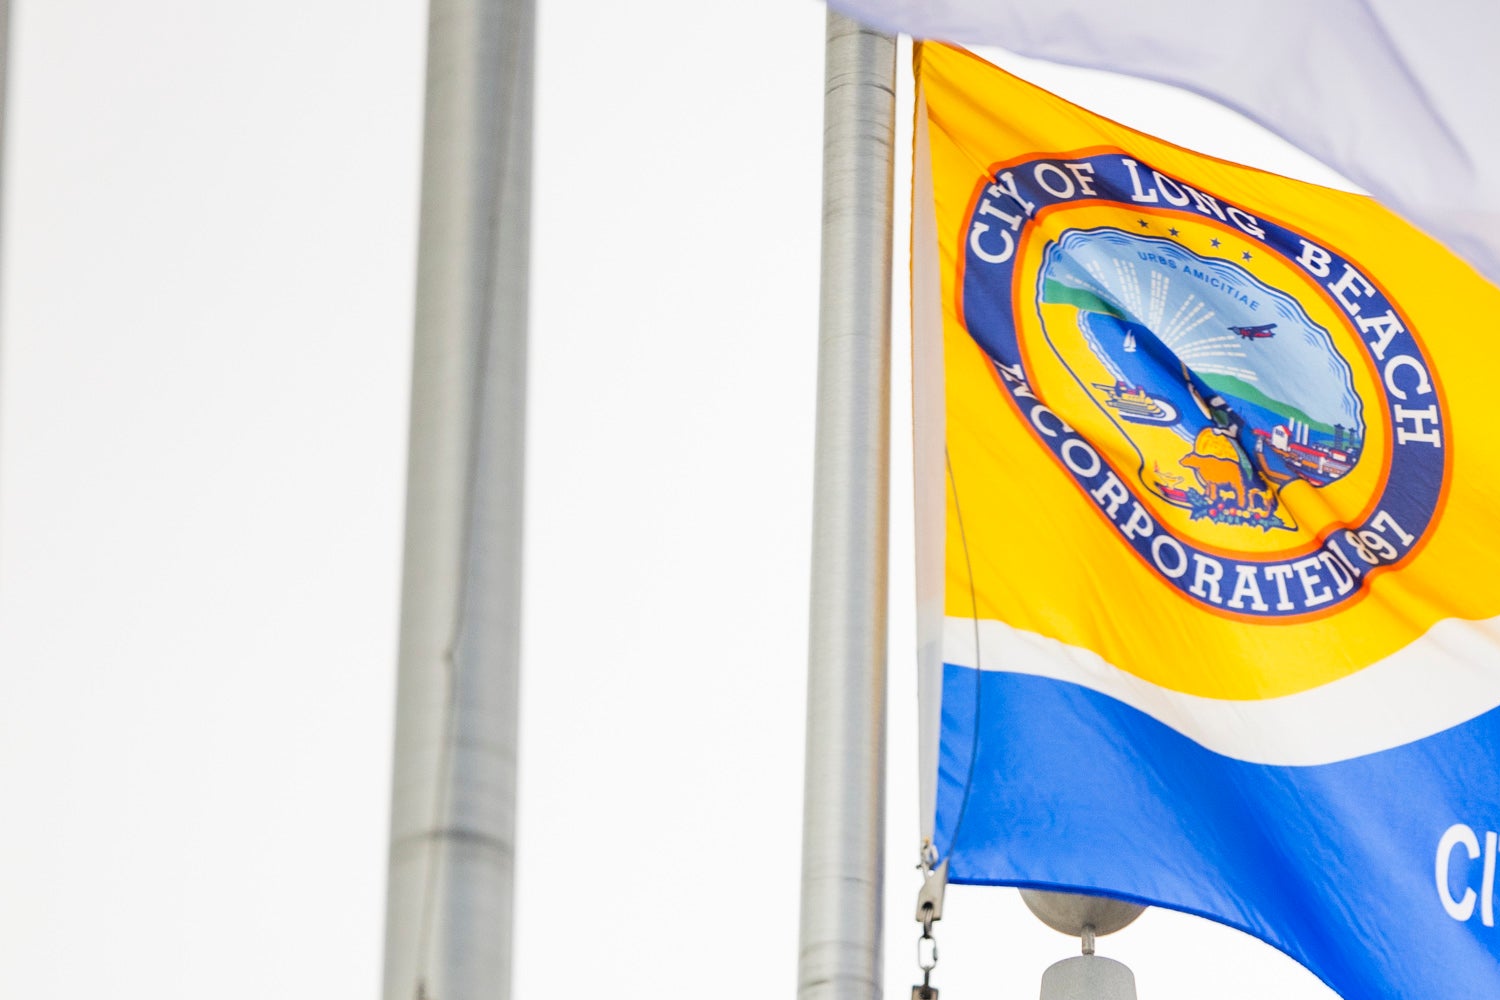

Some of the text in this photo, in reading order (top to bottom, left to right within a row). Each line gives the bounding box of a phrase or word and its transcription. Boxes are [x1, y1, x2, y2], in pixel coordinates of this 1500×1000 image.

[1034, 163, 1096, 198] OF
[1122, 159, 1265, 240] LONG
[1296, 240, 1442, 447] BEACH
[1137, 251, 1260, 311] URBS AMICITIAE
